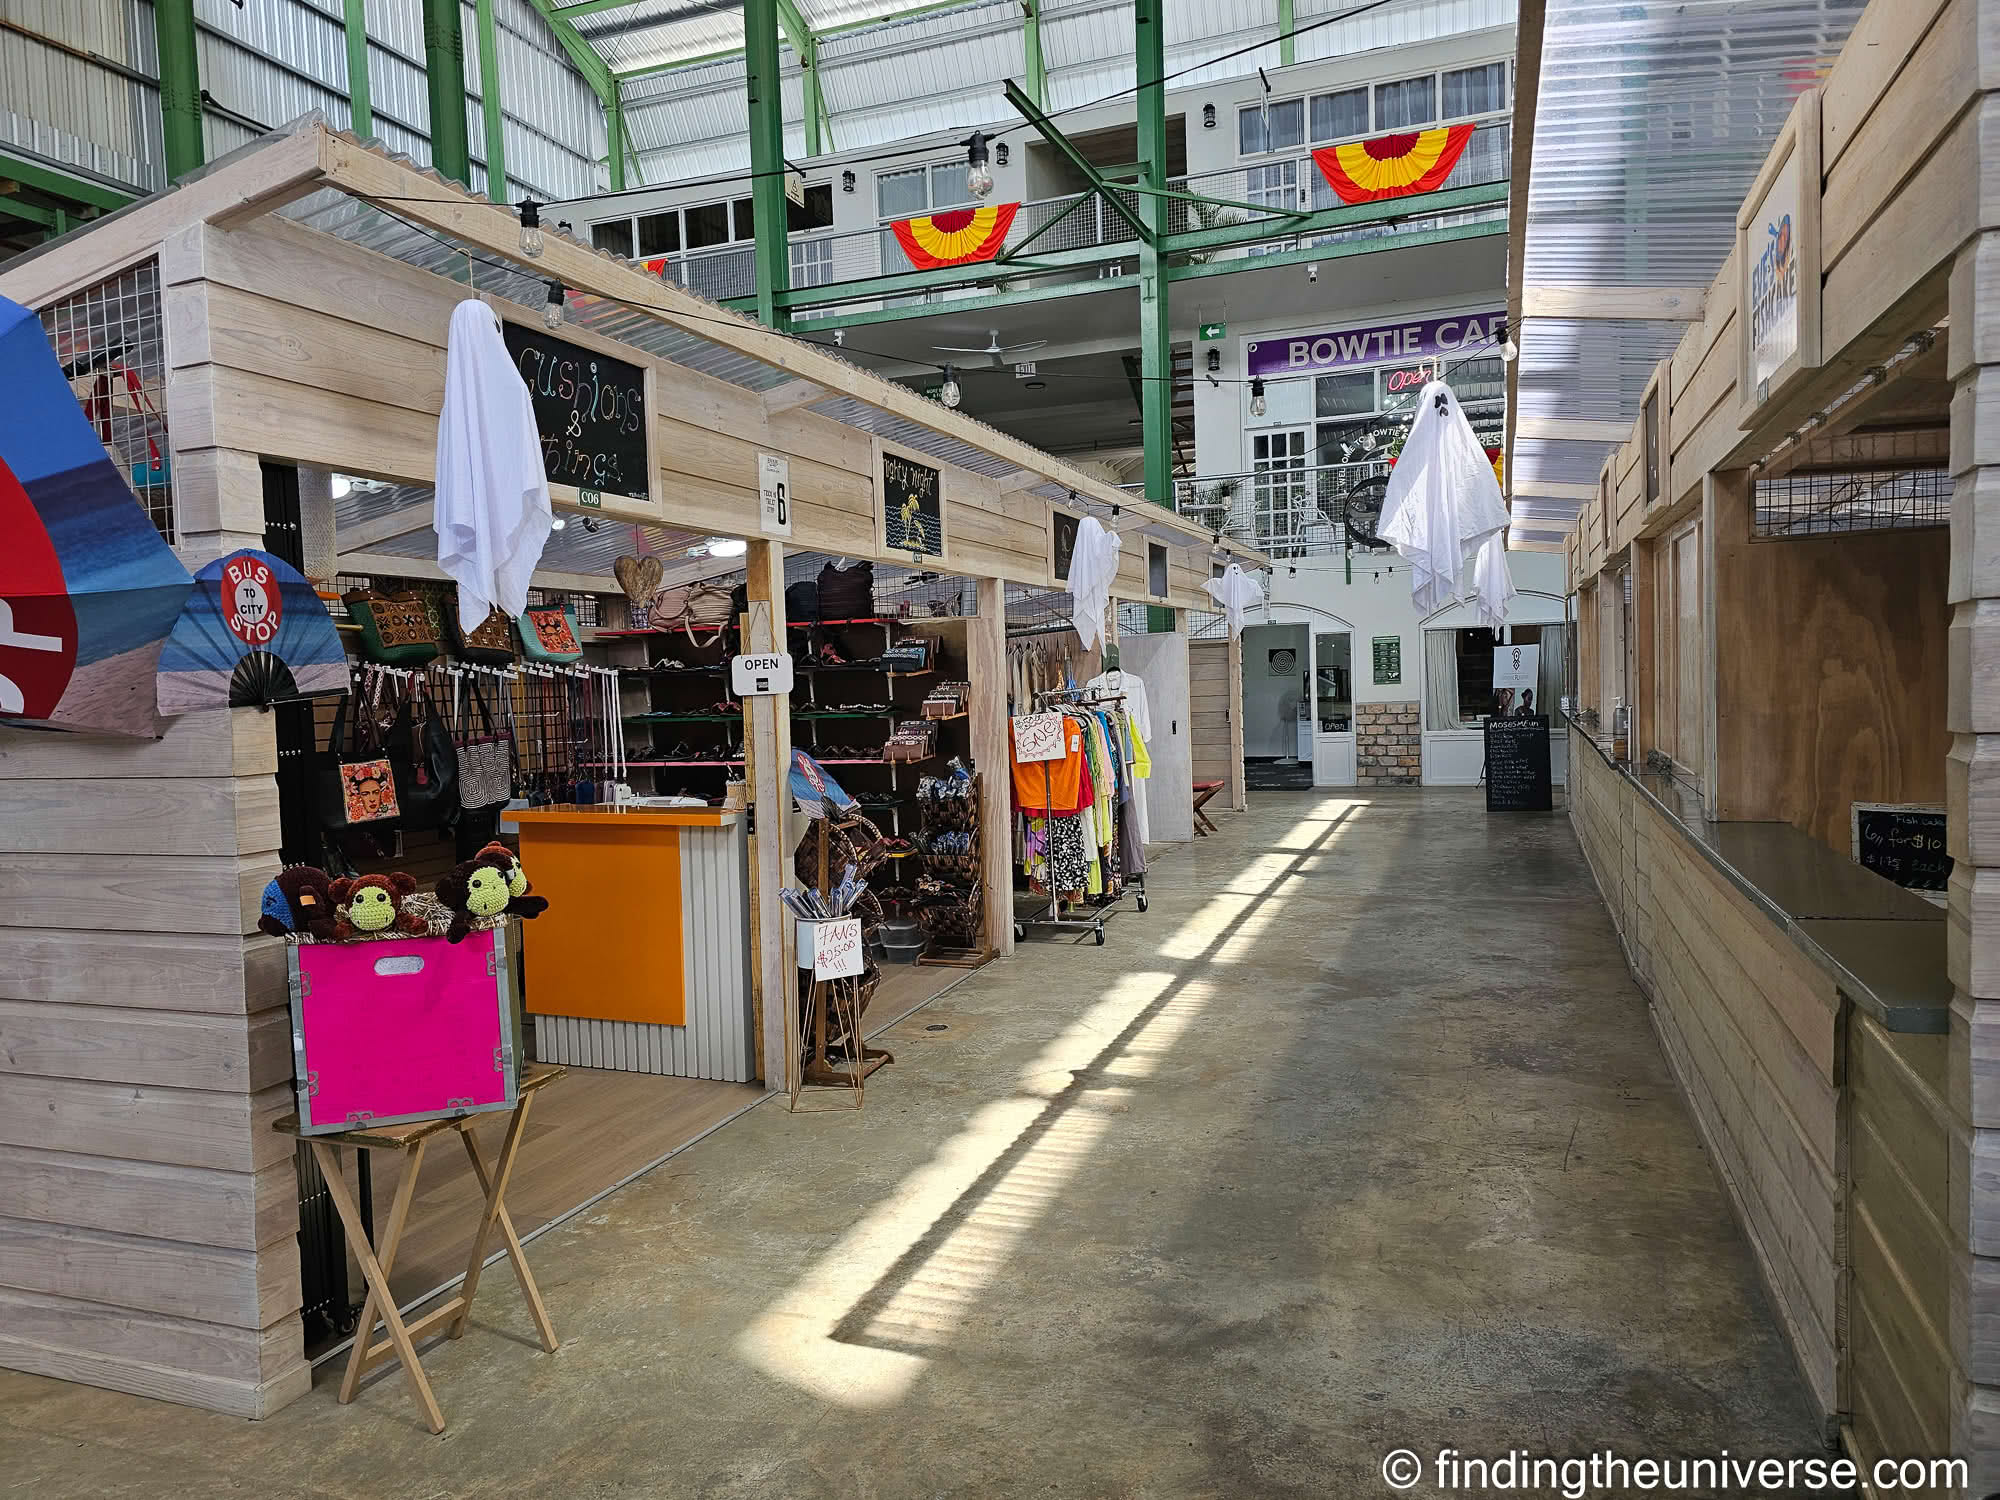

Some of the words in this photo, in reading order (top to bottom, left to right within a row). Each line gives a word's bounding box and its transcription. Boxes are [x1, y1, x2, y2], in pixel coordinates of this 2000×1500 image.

[1752, 257, 1798, 352] FISHCAKE
[1287, 325, 1423, 368] BOWTIE
[519, 347, 642, 434] Cushions
[1388, 368, 1434, 391] Open
[565, 409, 582, 438] &
[1370, 428, 1402, 439] OWTIE
[581, 491, 599, 505] C06
[776, 482, 787, 526] 6
[227, 560, 270, 585] BUS
[243, 587, 256, 599] TO
[240, 603, 264, 615] CITY
[230, 609, 279, 642] STOP
[744, 658, 779, 671] OPEN
[1888, 826, 1912, 848] for
[1911, 833, 1943, 851] $10
[818, 923, 858, 946] FANS
[816, 939, 856, 969] $25.00
